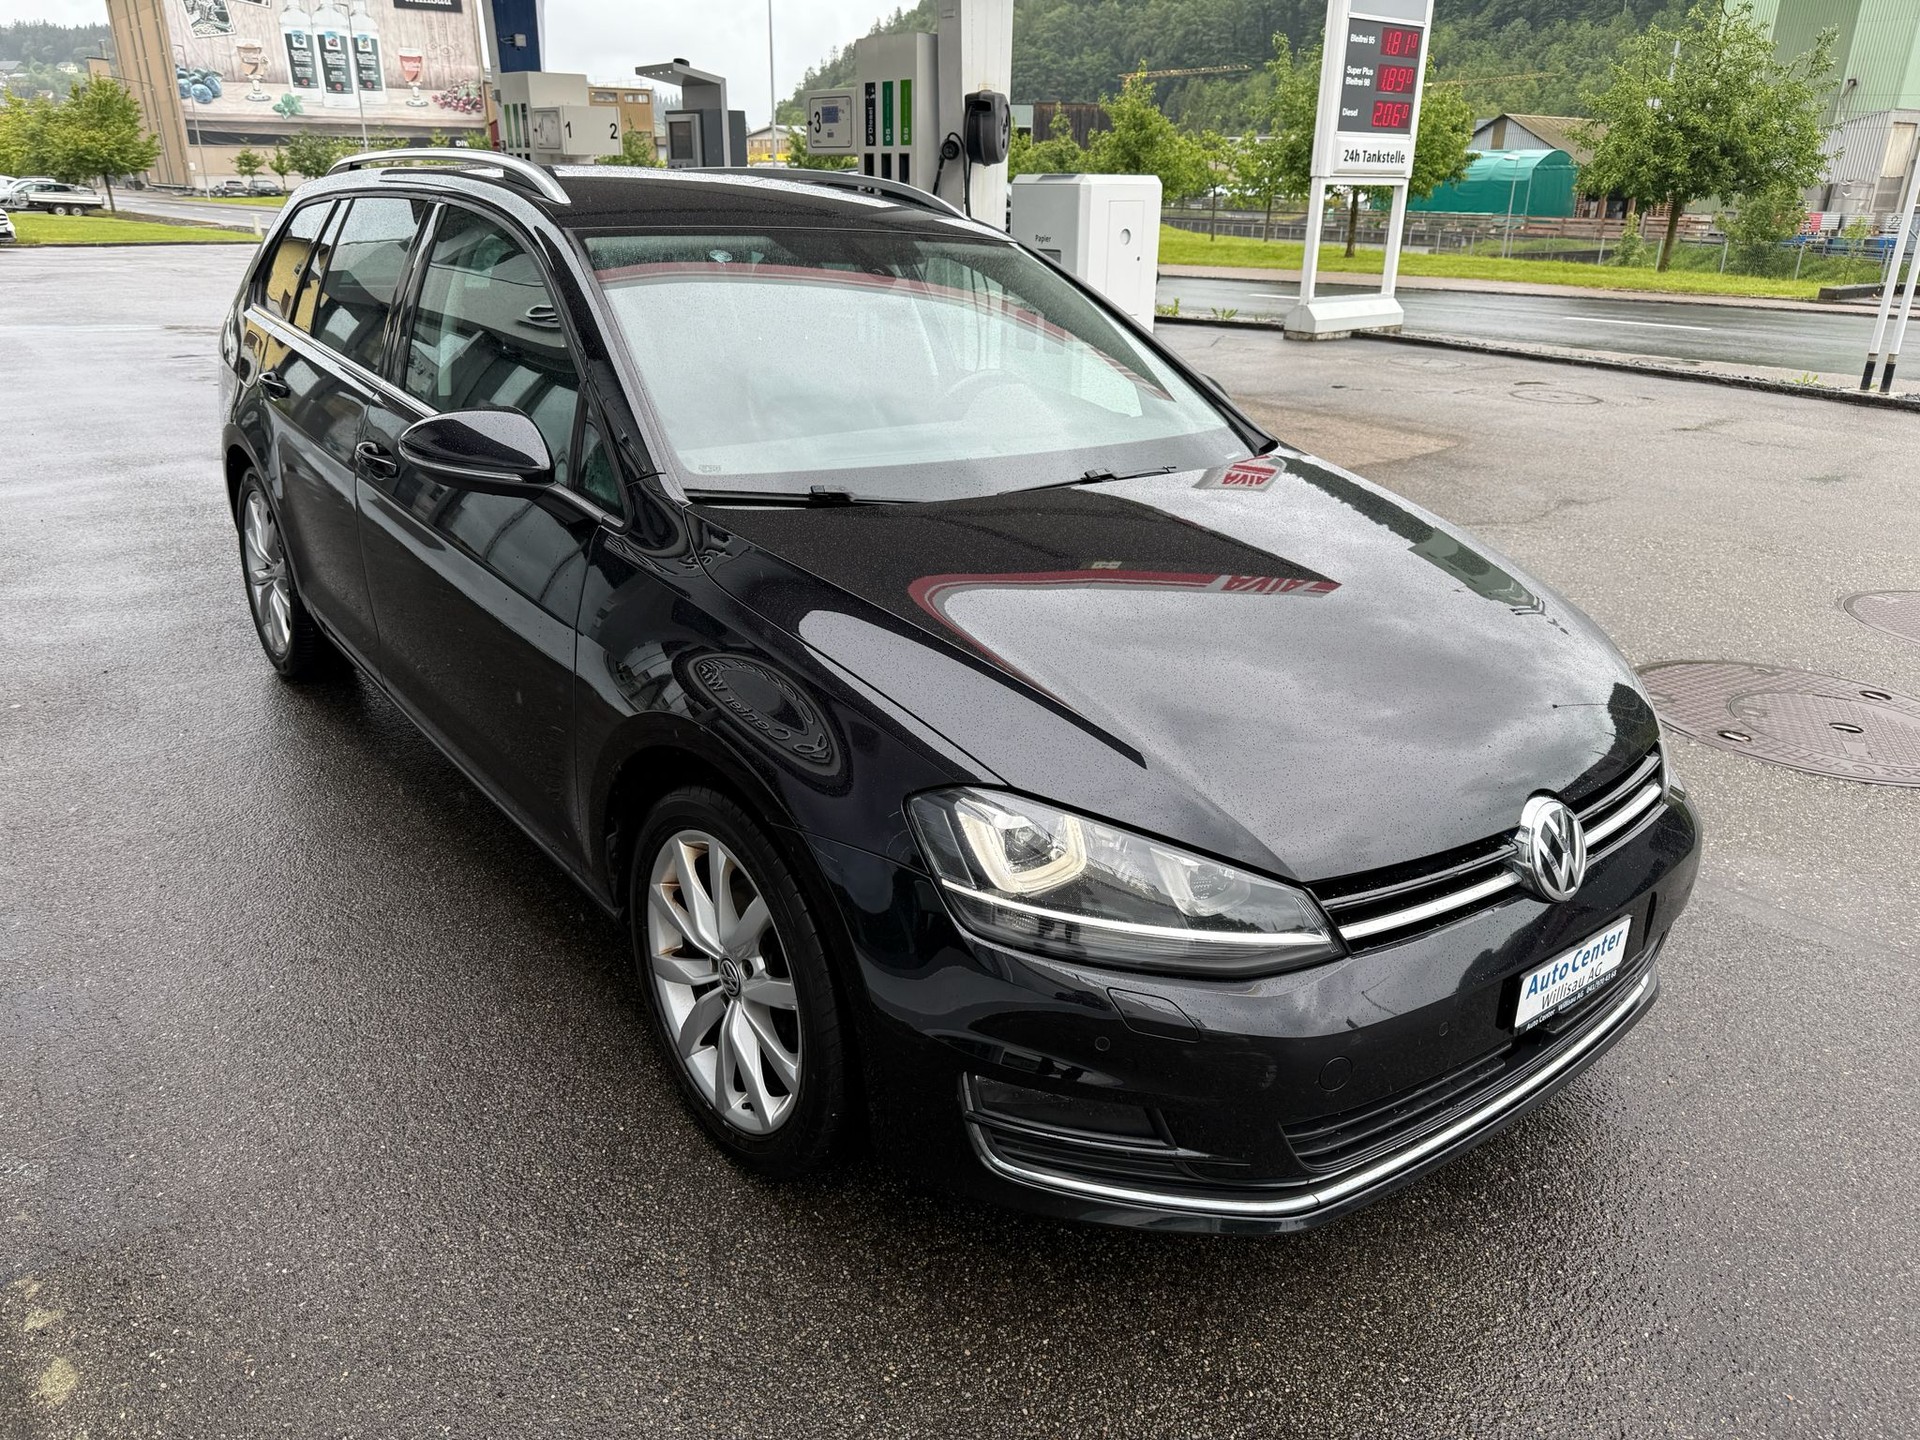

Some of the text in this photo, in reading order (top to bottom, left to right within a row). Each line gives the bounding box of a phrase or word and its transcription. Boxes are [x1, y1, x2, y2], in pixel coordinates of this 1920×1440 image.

[1350, 33, 1376, 44] Bleifrei 95
[1346, 65, 1374, 76] Super Plus
[1345, 76, 1363, 86] Bleifrei
[1342, 107, 1359, 117] Diesel
[814, 111, 821, 133] 3
[565, 121, 572, 138] 1
[609, 123, 618, 139] 2
[1343, 149, 1406, 163] 24h Tankstelle
[1035, 234, 1052, 244] Papier
[1541, 962, 1603, 1010] Willisau AG
